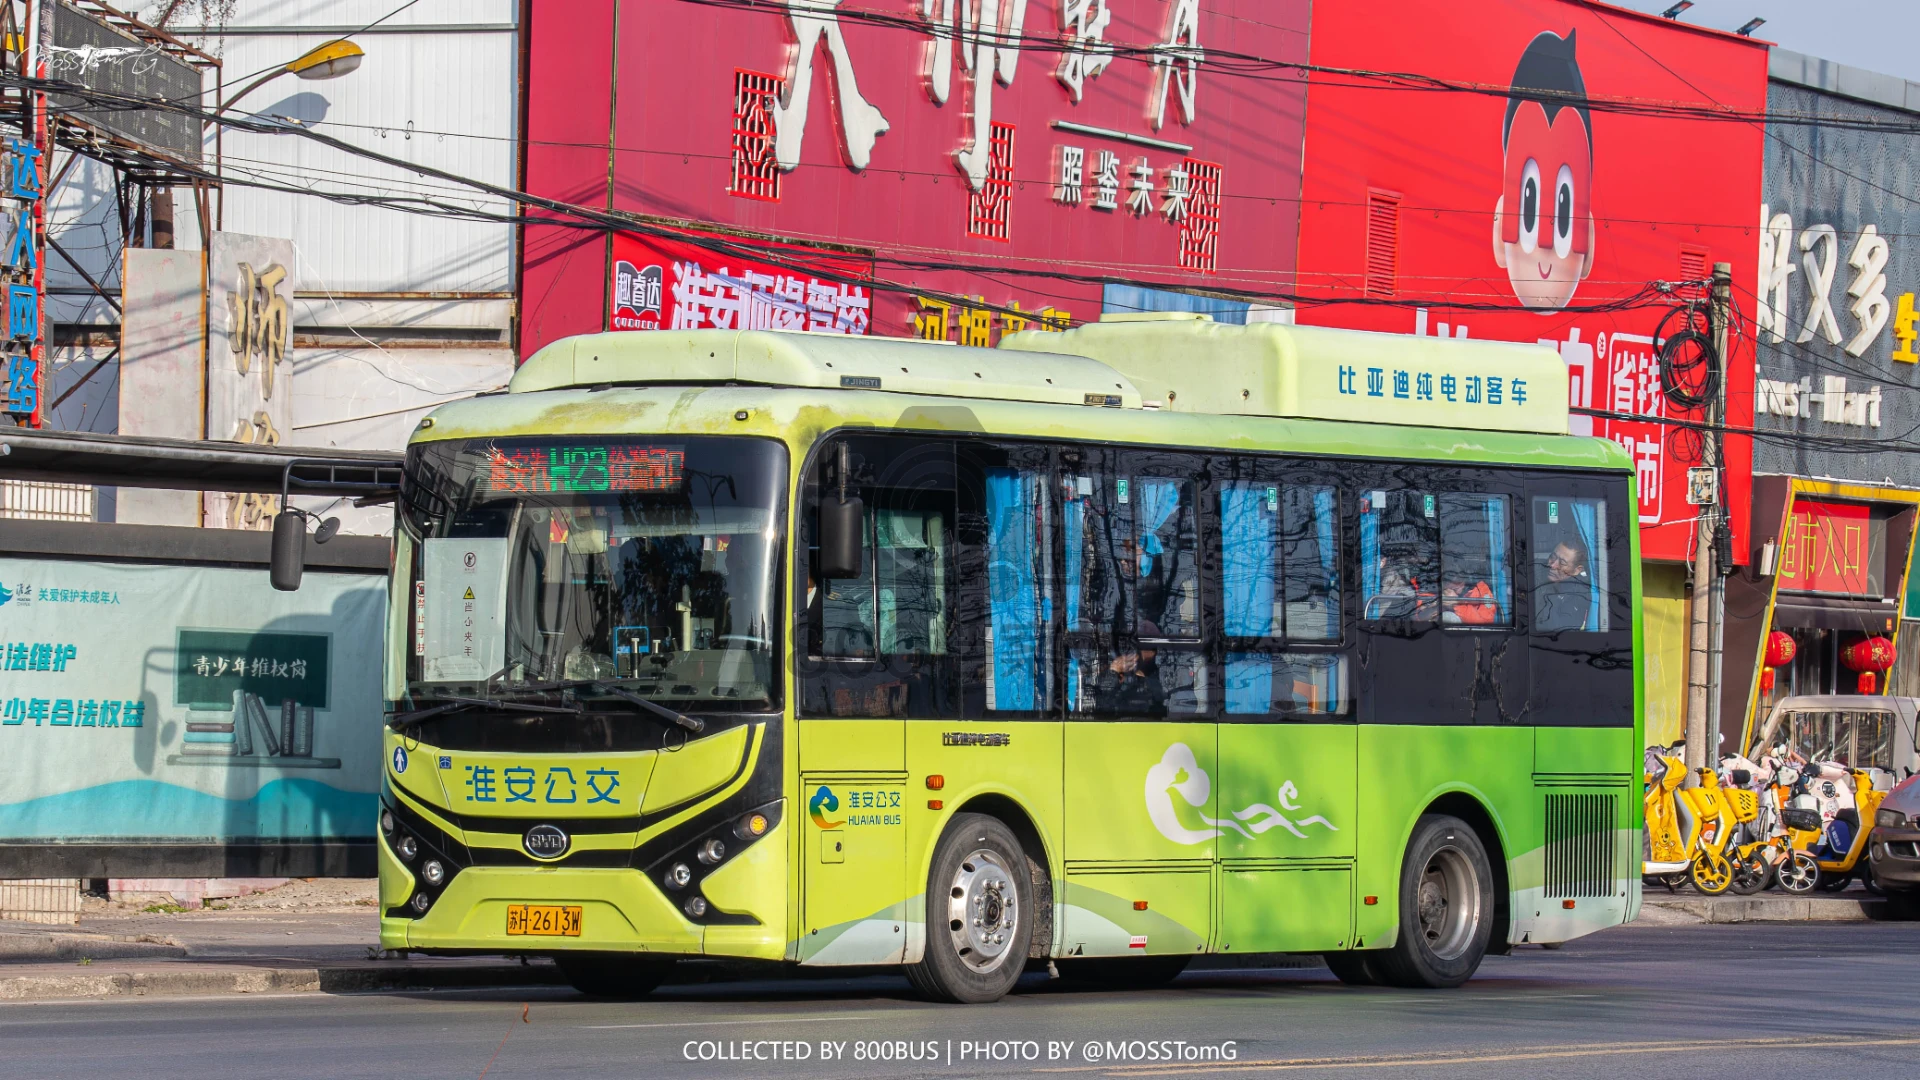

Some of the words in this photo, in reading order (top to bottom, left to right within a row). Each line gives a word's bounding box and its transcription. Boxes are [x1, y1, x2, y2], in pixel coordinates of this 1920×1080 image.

[1055, 145, 1189, 220] 照鉴未来
[11, 138, 40, 413] 达人网络
[671, 261, 869, 335] 淮安师缘驾校
[850, 378, 879, 387] JINGYI
[1338, 364, 1528, 406] 比亚迪纯电动客车
[1612, 350, 1662, 423] 省钱
[1756, 372, 1882, 427] rust-Mart
[550, 447, 610, 492] H23
[38, 588, 121, 605] 关爱保护未成年人
[0, 642, 77, 672] 法维护
[193, 655, 307, 680] 青少年维权岗
[0, 697, 146, 728] 少年合法权益
[464, 765, 621, 805] 淮安公交
[848, 791, 901, 809] 淮安公交
[848, 815, 881, 827] HUAIAN
[883, 815, 901, 826] BUS
